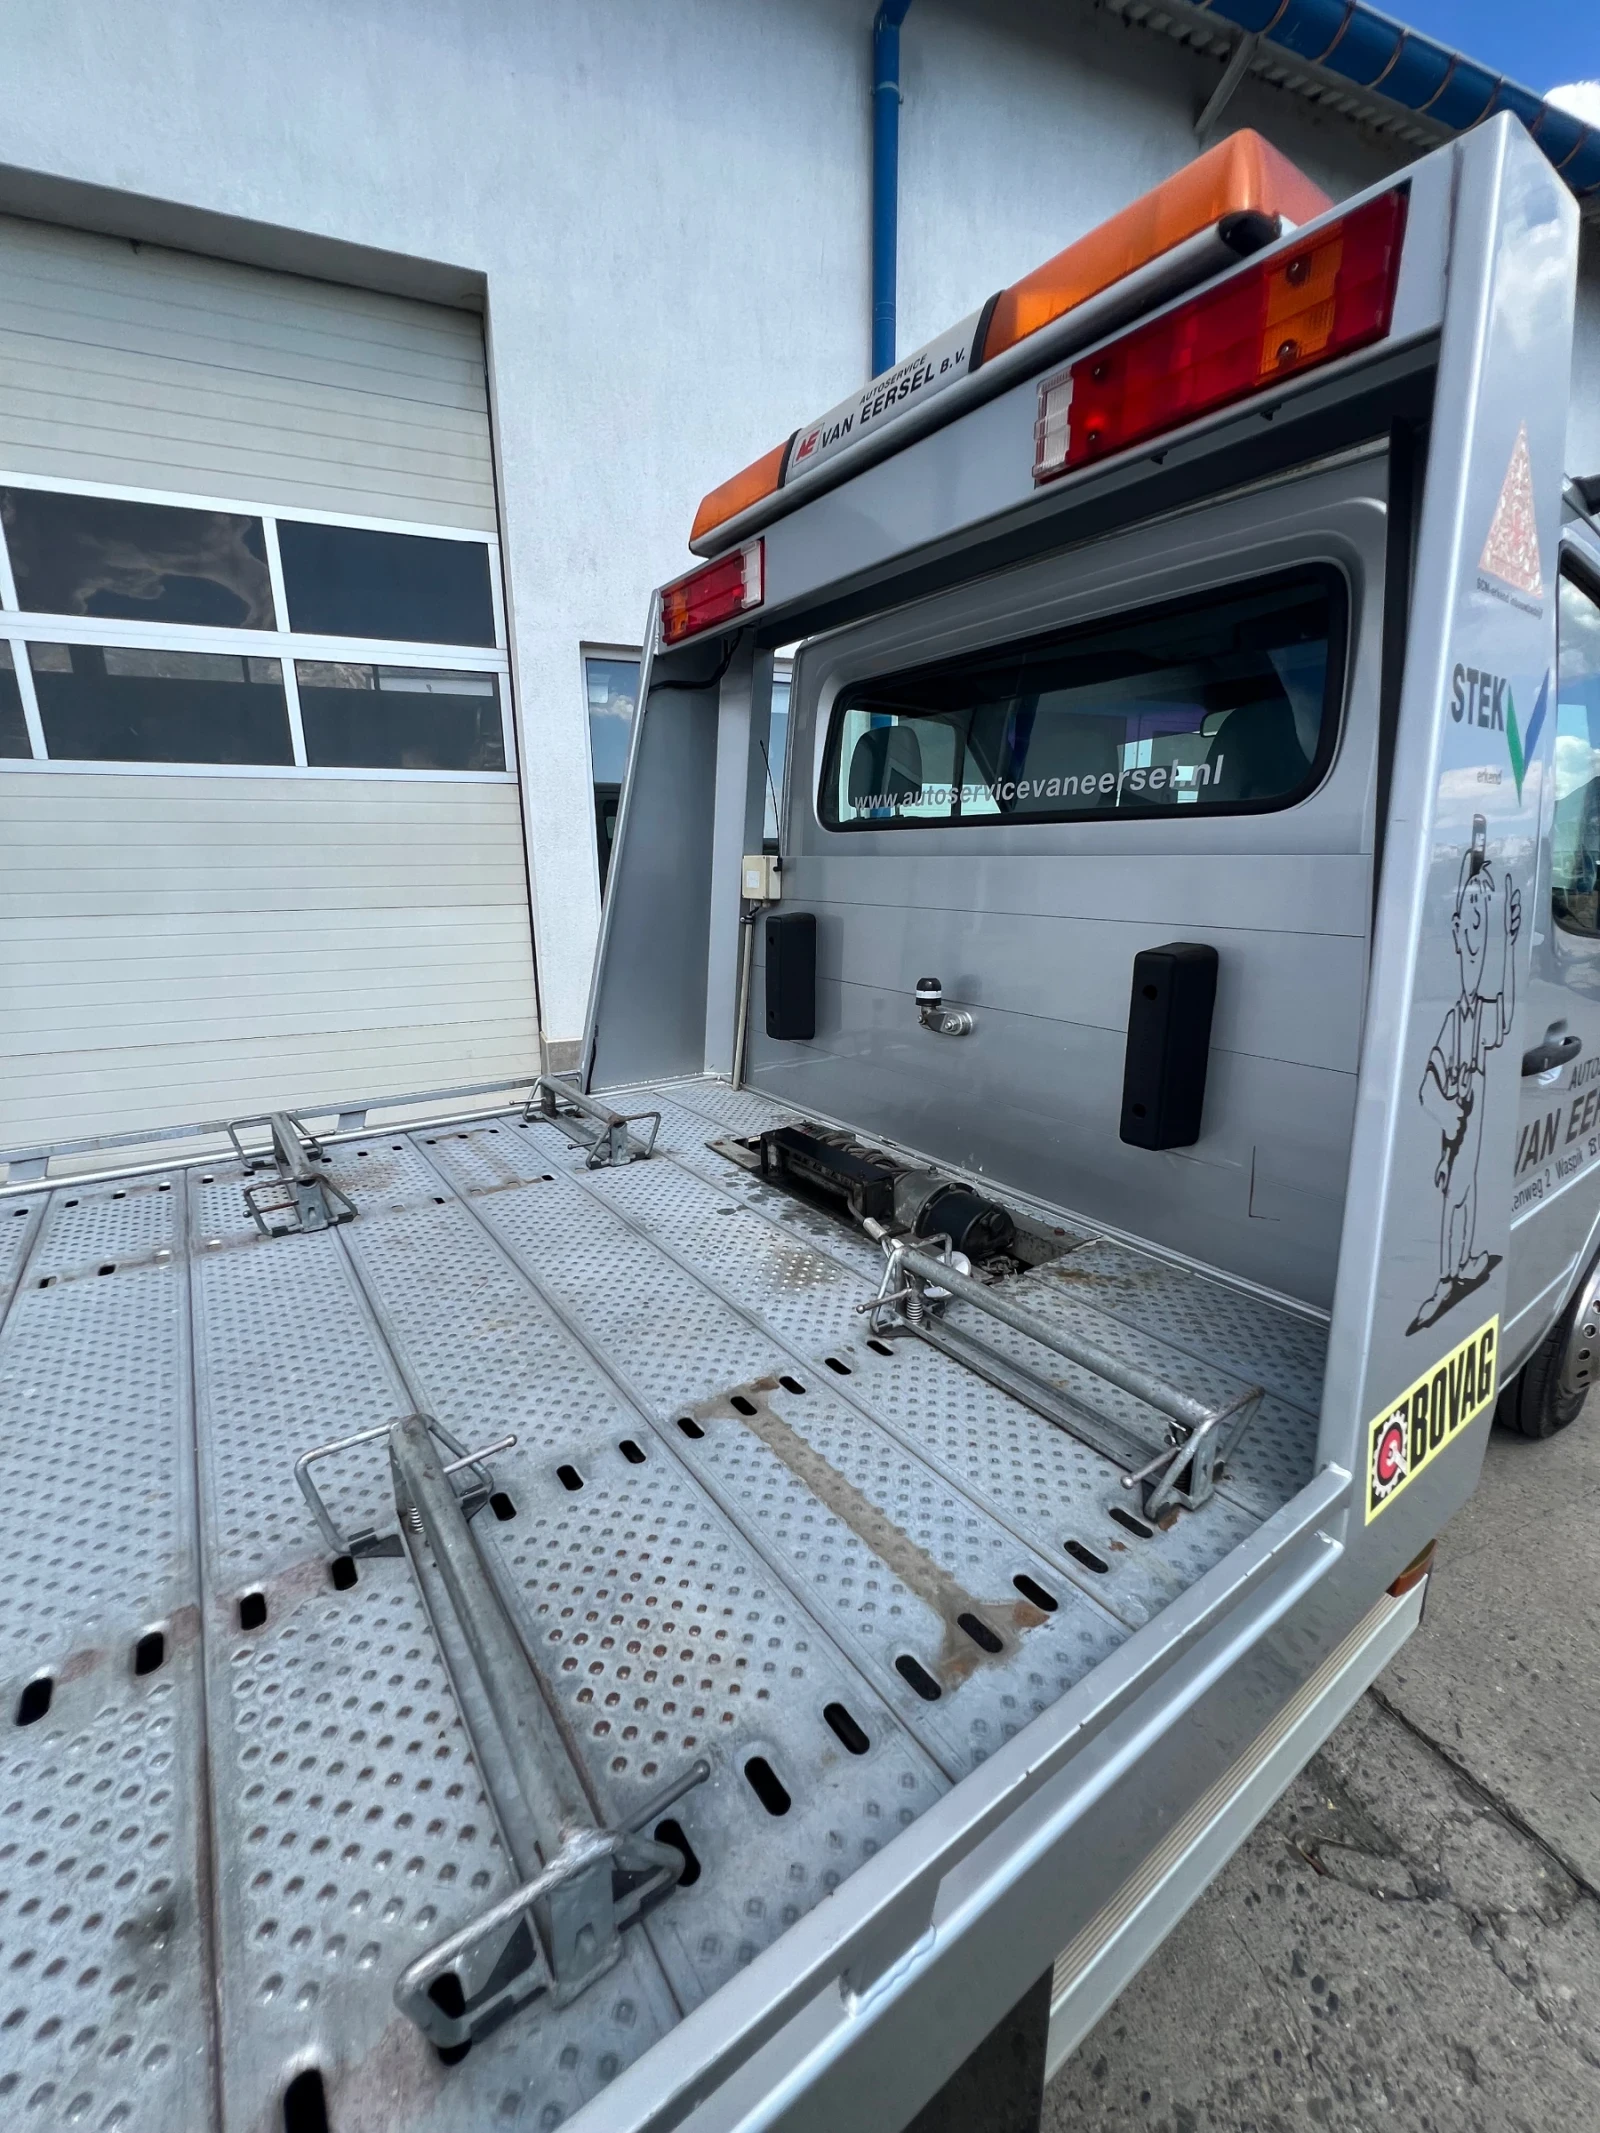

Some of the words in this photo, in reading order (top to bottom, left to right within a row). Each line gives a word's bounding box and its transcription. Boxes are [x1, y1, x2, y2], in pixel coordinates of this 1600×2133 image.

[822, 414, 854, 448] VAN
[860, 363, 935, 424] EERSEL
[860, 354, 927, 404] AUTOSERVICE
[1451, 663, 1505, 732] STEK
[854, 755, 1224, 811] www.autoservicevaneersel.nl
[1569, 1058, 1600, 1091] AUTO
[1511, 1179, 1543, 1212] enweg
[1545, 1169, 1551, 1187] 2
[1410, 1327, 1494, 1473] BOVAG
